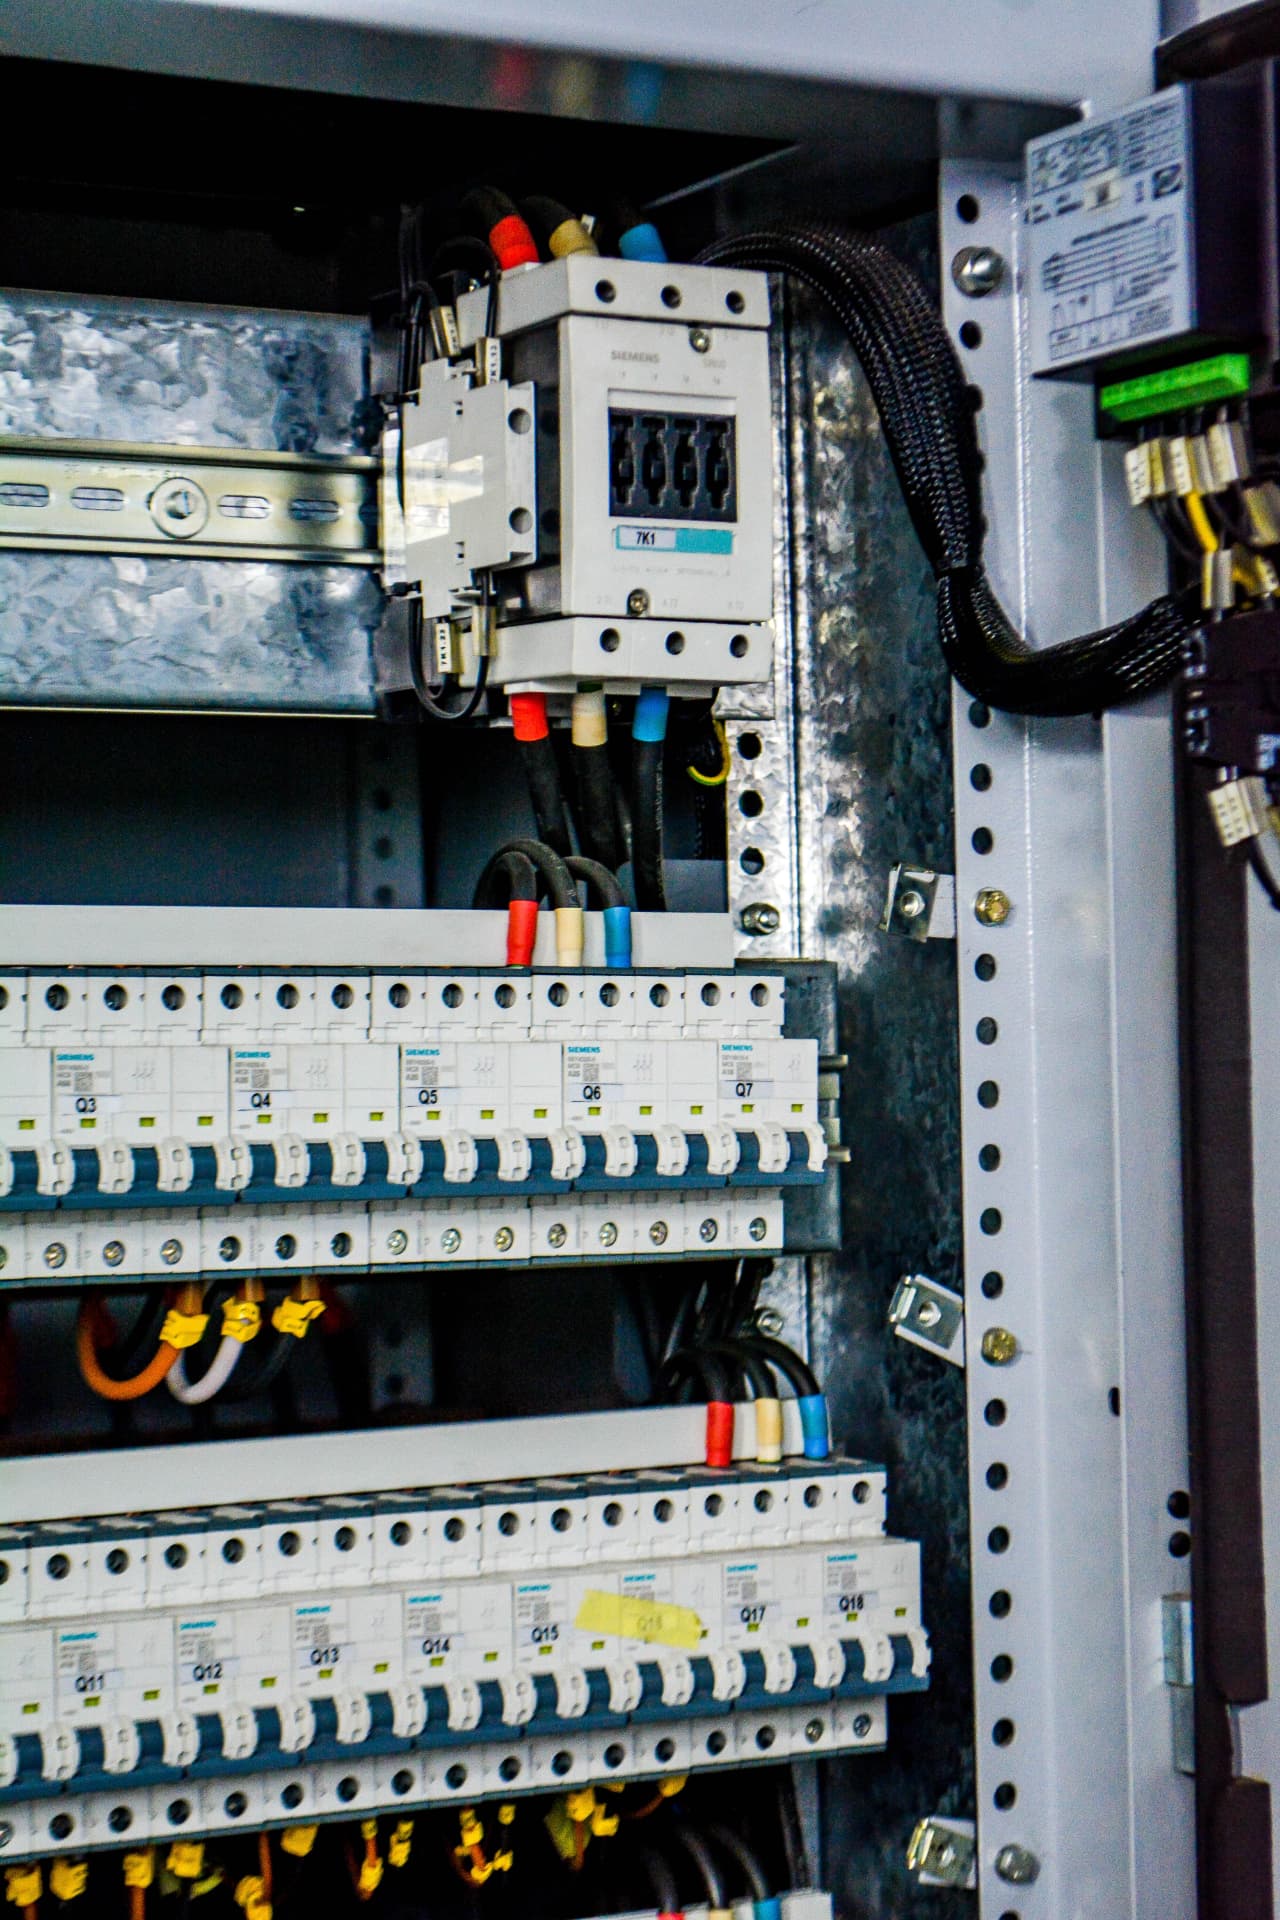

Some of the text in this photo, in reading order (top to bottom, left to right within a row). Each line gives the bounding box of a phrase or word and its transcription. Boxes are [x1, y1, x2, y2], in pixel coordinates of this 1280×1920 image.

[610, 350, 661, 364] SIEMENS
[635, 531, 656, 546] 7K1
[567, 1046, 601, 1054] SIEMENS
[418, 1089, 439, 1105] Q5
[582, 1085, 602, 1101] Q6
[735, 1082, 754, 1098] Q7
[74, 1097, 97, 1114] Q3
[250, 1092, 272, 1109] Q4
[838, 1594, 865, 1612] Q18
[740, 1605, 767, 1623] Q17
[531, 1624, 560, 1643] Q15
[421, 1638, 452, 1655] Q14
[310, 1647, 341, 1666] Q13
[192, 1661, 225, 1682] Q12
[74, 1674, 106, 1693] Q11
